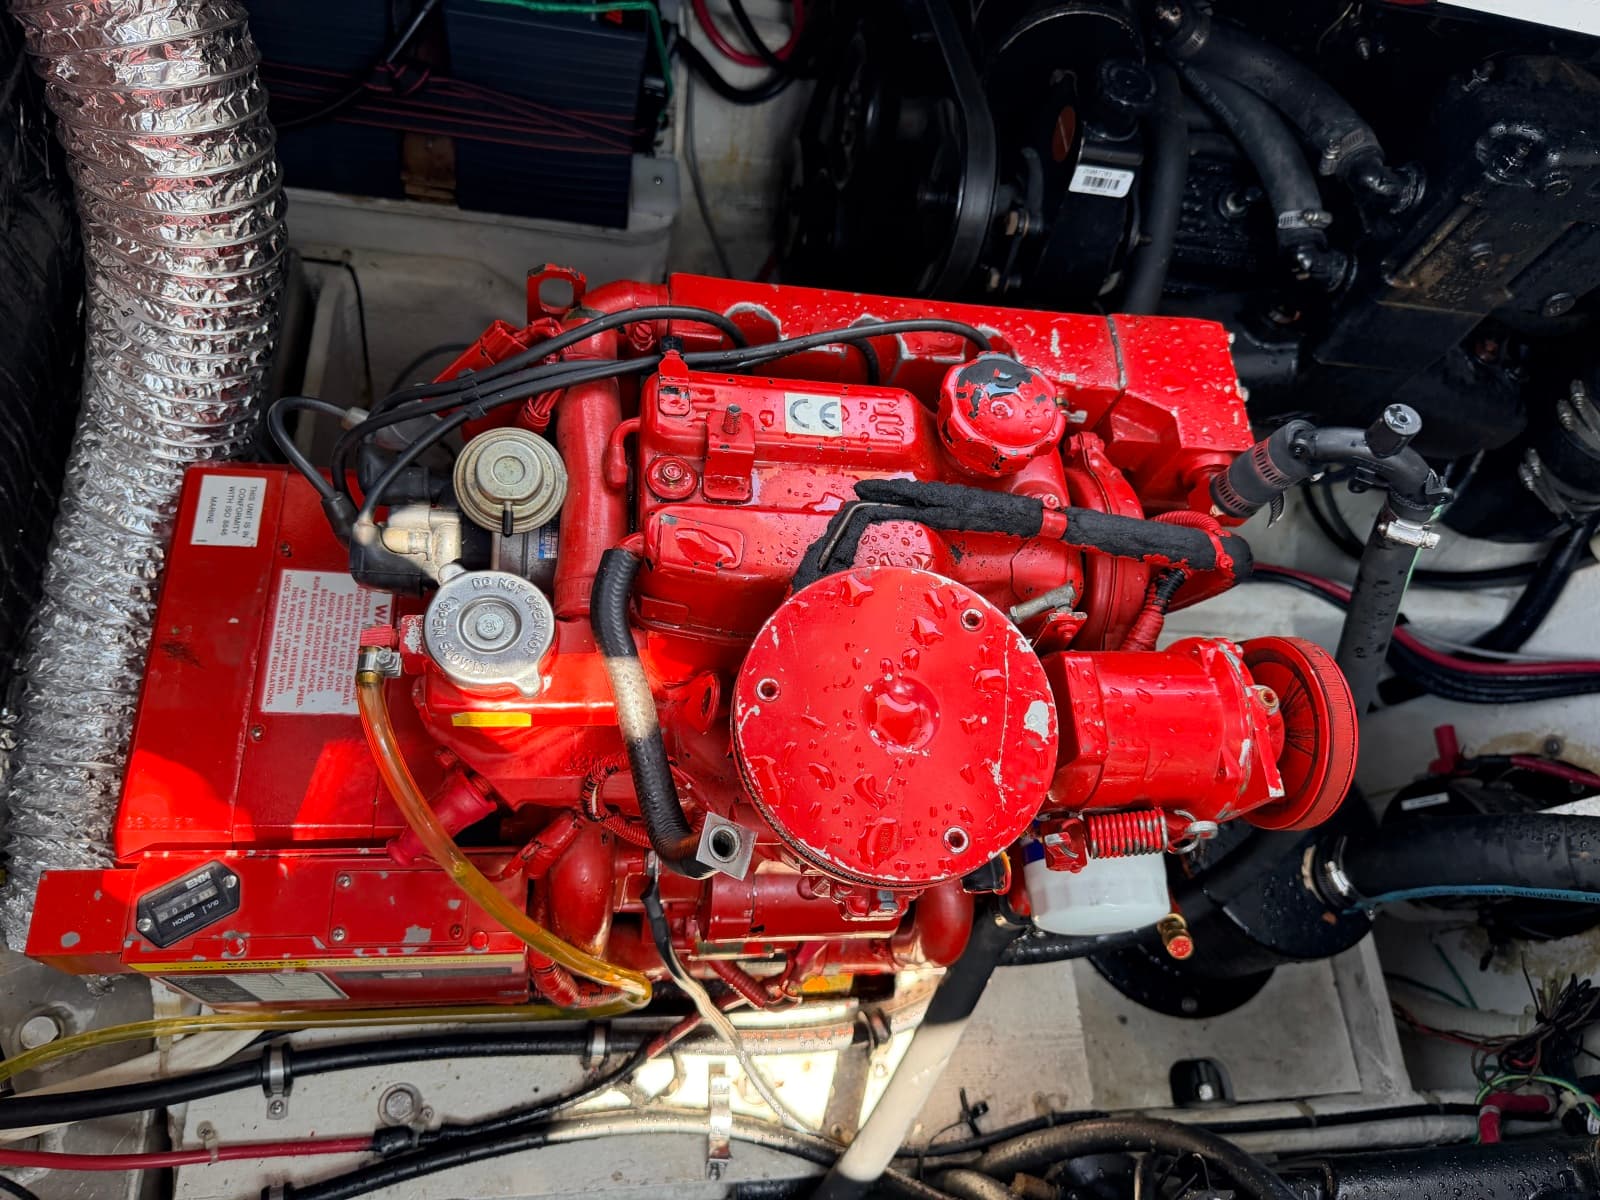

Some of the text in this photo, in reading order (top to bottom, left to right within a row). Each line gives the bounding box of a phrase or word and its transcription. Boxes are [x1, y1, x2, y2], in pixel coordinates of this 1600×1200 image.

[789, 398, 839, 431] CE
[227, 486, 236, 503] WITH
[249, 486, 257, 501] THIS
[206, 496, 219, 524] MARINE
[224, 506, 232, 517] ISO
[232, 489, 247, 534] CONFORMITY
[246, 504, 254, 519] UNIT
[284, 575, 292, 591] USCG
[308, 593, 318, 620] BLOWER
[319, 589, 328, 606] BILGE
[335, 596, 343, 624] MINUTES
[344, 593, 353, 620] BLOWER
[362, 591, 372, 618] ASOLINE
[472, 577, 491, 590] DO
[498, 577, 527, 594] NOT
[525, 595, 545, 630] OPEN
[286, 604, 296, 635] PRODUCT
[295, 602, 305, 631] SUPPLIED
[350, 609, 359, 640] STARTING
[274, 631, 283, 653] SAFETY
[294, 635, 300, 643] BY
[305, 623, 313, 646] BELOW
[312, 626, 322, 660] GASOLINE
[317, 593, 336, 692] ENGINE COMPARTMENT AND
[341, 640, 347, 648] AT
[280, 639, 290, 672] COMPLIES
[299, 649, 310, 682] CRUISING
[329, 646, 337, 667] CHECK
[265, 657, 279, 706] REGULATIONS.
[277, 676, 286, 694] WITH
[307, 665, 317, 695] VAPORS.
[326, 671, 334, 689] BOTH
[335, 673, 343, 692] FOUR
[342, 675, 351, 705] OPERATE
[296, 686, 305, 708] SPEED.
[172, 911, 195, 927] HOURS
